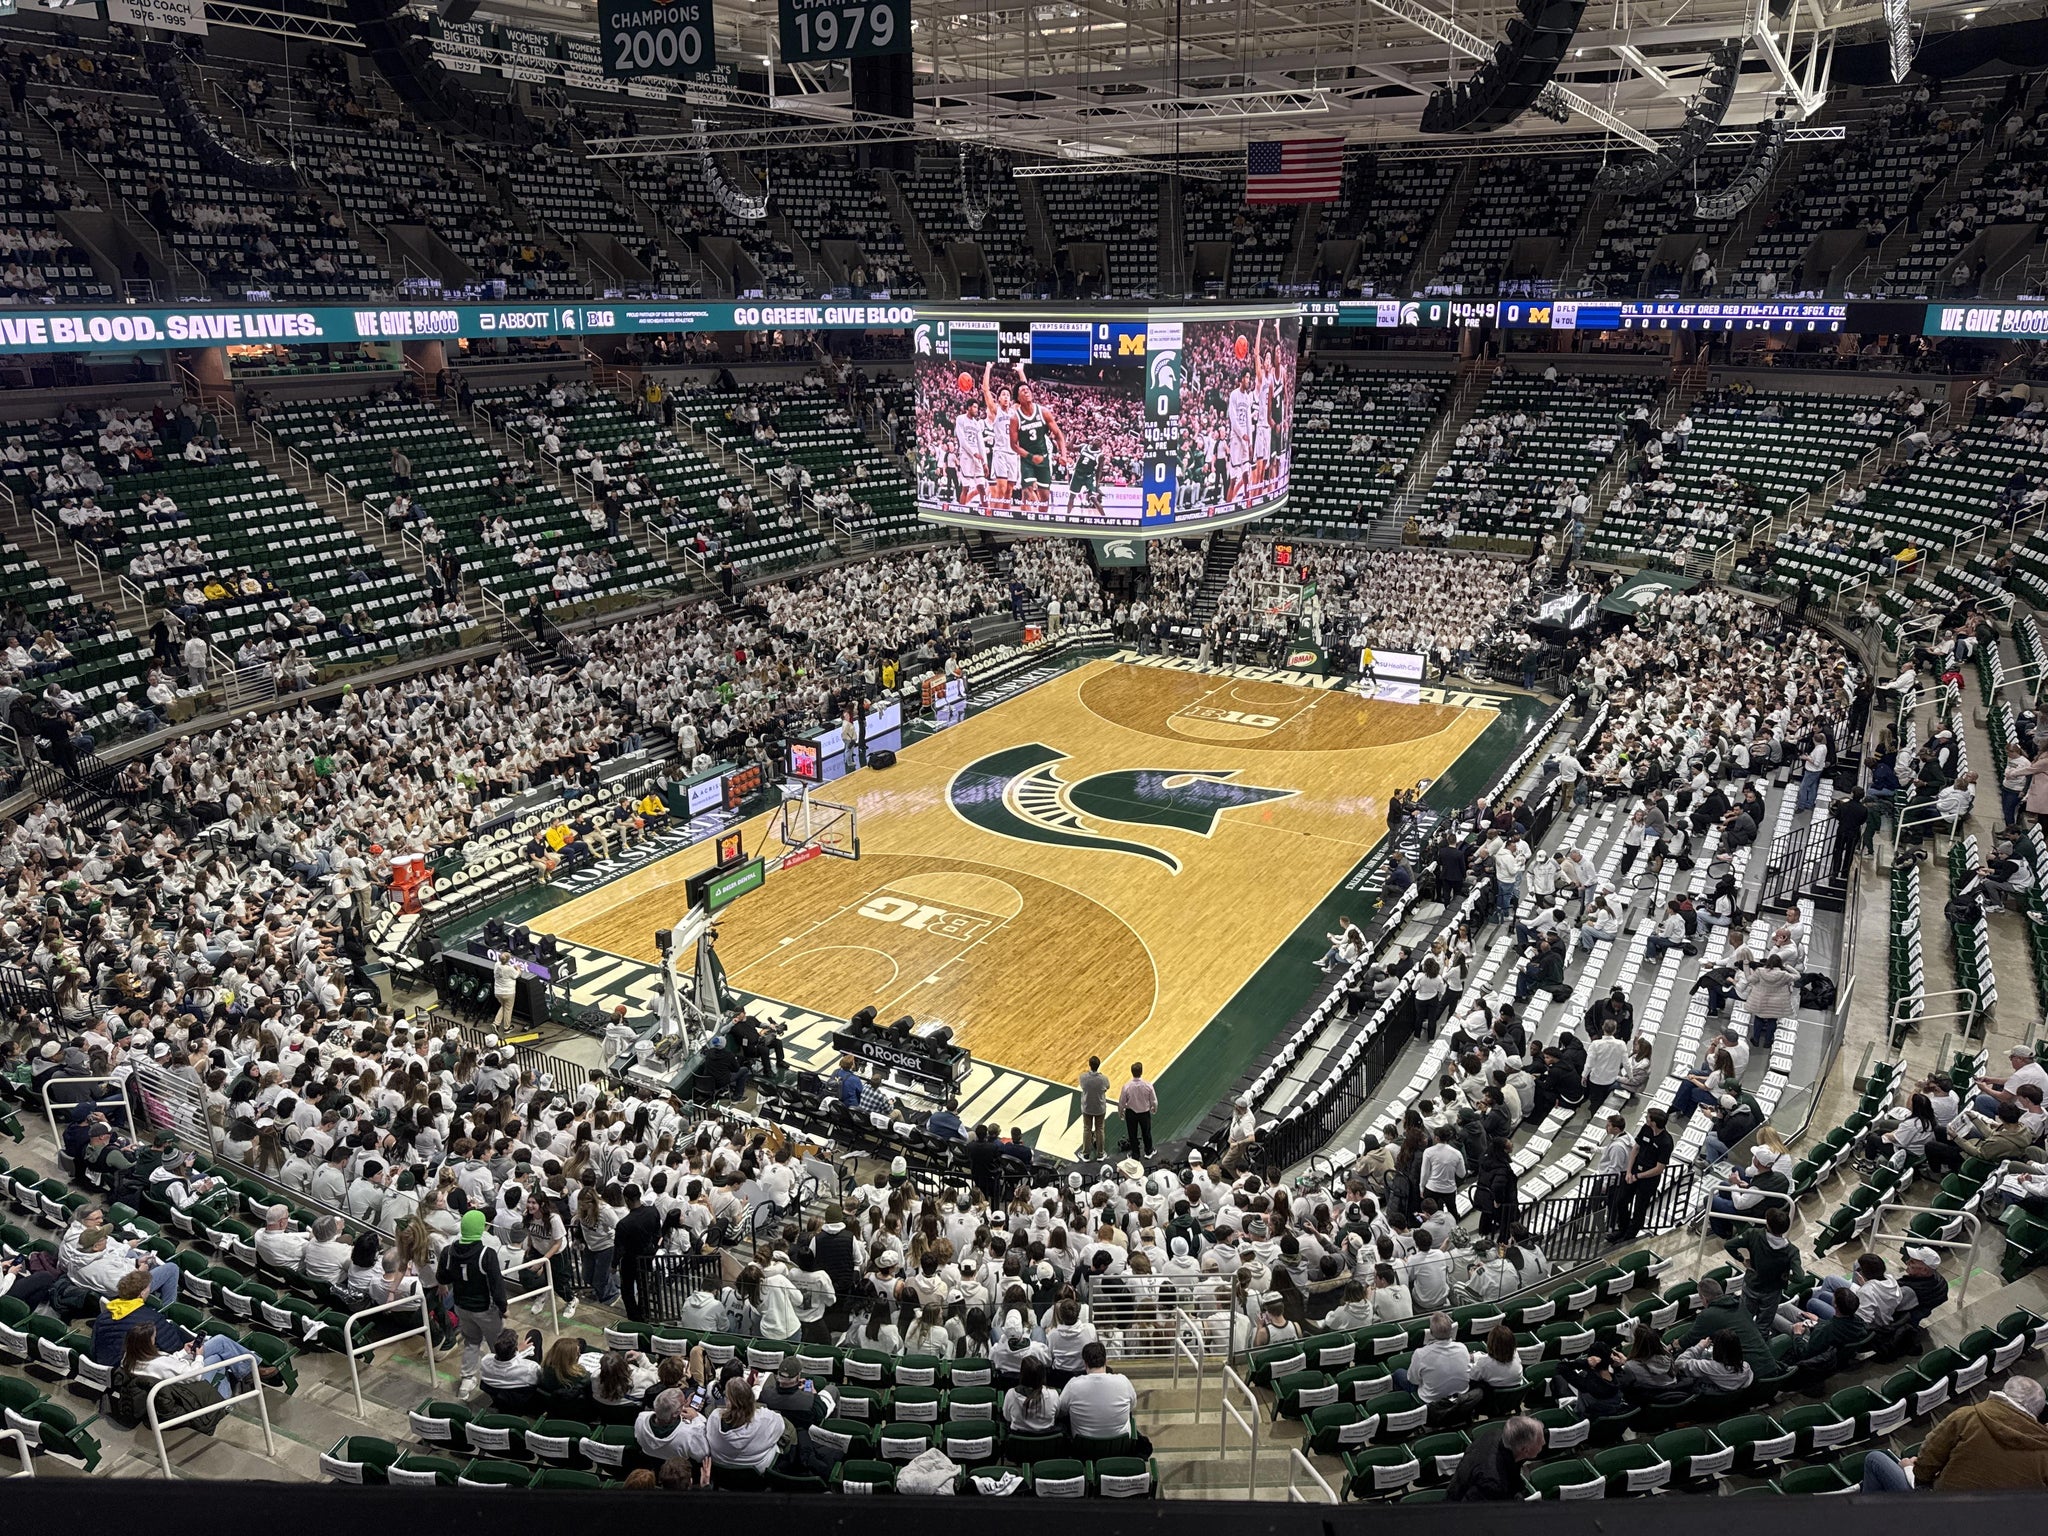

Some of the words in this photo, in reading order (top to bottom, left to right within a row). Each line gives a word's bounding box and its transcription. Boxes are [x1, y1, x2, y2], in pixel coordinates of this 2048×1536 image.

[154, 0, 190, 14] COACH
[131, 9, 154, 21] 1976
[163, 14, 186, 26] 1995
[611, 5, 700, 29] CHAMPIONS
[795, 4, 894, 53] 1979
[443, 30, 460, 43] BIG
[462, 34, 481, 46] TEN
[506, 29, 549, 47] WOMEN'S
[530, 44, 546, 57] TEN
[613, 26, 702, 70] 2000
[695, 72, 710, 82] BIG
[712, 74, 728, 84] TEN
[734, 308, 760, 325] GO
[761, 308, 823, 325] GREEN.
[825, 307, 865, 324] GIVE
[866, 307, 917, 324] BLOO
[1311, 304, 1320, 312] TO
[1324, 304, 1338, 312] STL
[1430, 305, 1441, 321] 0
[1452, 304, 1494, 318] 40:49
[1507, 305, 1519, 322] 0
[1528, 307, 1551, 323] M
[1622, 305, 1637, 314] STL
[1642, 305, 1653, 314] TO
[1657, 305, 1674, 314] BLK
[1678, 305, 1695, 315] AST
[1697, 305, 1720, 315] OREB
[1722, 305, 1740, 315] REB
[1741, 305, 1779, 315] FTM-FTA
[1782, 305, 1799, 316] FT%
[1802, 305, 1825, 316] 3FG%
[1828, 306, 1846, 316] FG%
[50, 316, 165, 343] BLOOD.
[167, 315, 243, 340] SAVE
[243, 313, 324, 338] LIVES.
[354, 311, 379, 336] WE
[379, 311, 413, 336] GIVE
[413, 310, 460, 334] BLOOD
[498, 312, 549, 329] ABBOTT
[1312, 316, 1318, 325] 0
[1327, 316, 1334, 325] 0
[1465, 319, 1480, 327] PRE
[1624, 319, 1632, 328] 0
[1641, 319, 1649, 328] 0
[1659, 319, 1668, 329] 0
[1680, 319, 1689, 329] 0
[1702, 319, 1710, 329] 0
[1724, 319, 1733, 330] 0
[1784, 320, 1793, 331] 0
[1807, 321, 1815, 331] 0
[1830, 321, 1839, 332] 0
[1940, 308, 1965, 331] WE
[1965, 308, 2002, 332] GIVE
[937, 321, 945, 337] 0
[1099, 323, 1109, 339] 0
[999, 332, 1031, 345] 40:49
[1118, 334, 1146, 355] M
[1008, 349, 1020, 357] PRE
[1157, 395, 1169, 415] 0
[1144, 427, 1180, 441] 40:49
[1155, 441, 1168, 450] PRE
[1155, 463, 1166, 483] 0
[1146, 492, 1172, 517] M
[1287, 655, 1315, 667] LIBMAN
[1388, 661, 1407, 671] Health
[550, 859, 632, 891] FOR
[737, 872, 757, 886] DENTAL
[874, 1045, 922, 1071] Rocket
[1163, 1175, 1171, 1189] 1
[460, 1263, 469, 1282] 1
